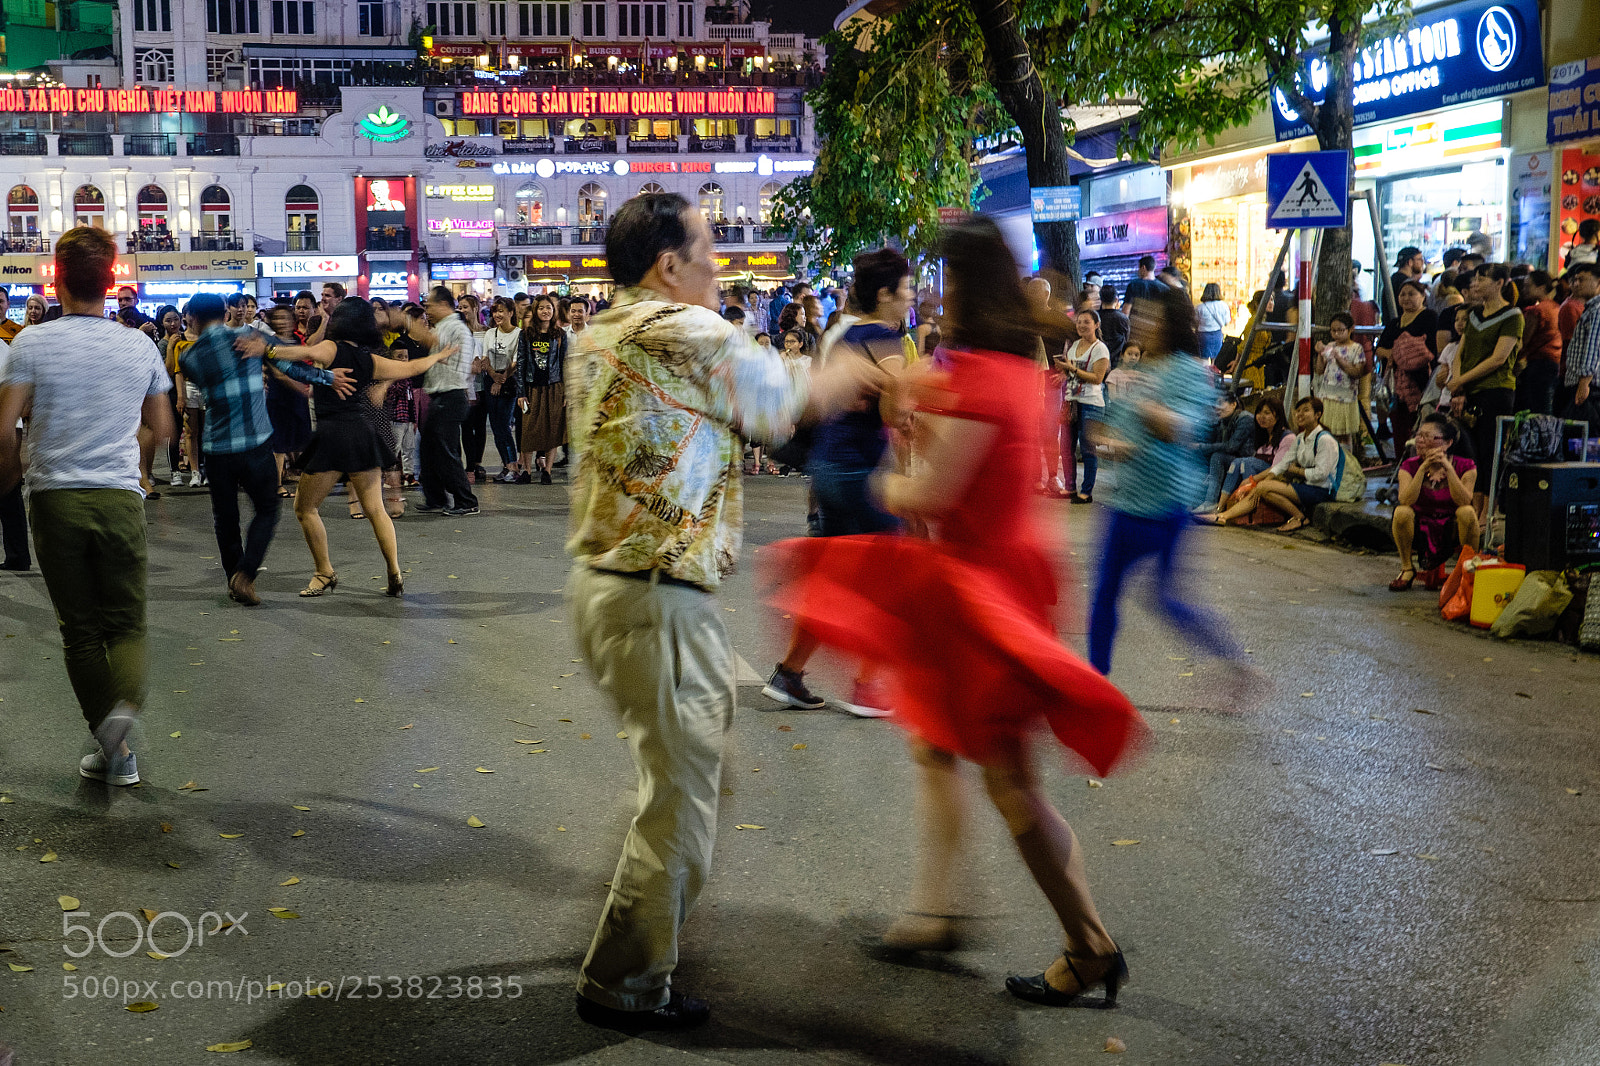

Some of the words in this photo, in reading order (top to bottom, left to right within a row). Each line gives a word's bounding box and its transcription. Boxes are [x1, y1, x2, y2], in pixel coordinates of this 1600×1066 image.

[1408, 18, 1461, 66] TOUR
[440, 46, 473, 54] COFFEE
[589, 47, 622, 55] BURGER
[691, 47, 745, 55] SANDWCH
[1391, 65, 1440, 96] OFFICE
[29, 83, 48, 112] XÃ
[50, 84, 74, 117] HỘI
[77, 82, 105, 112] CHỦ
[107, 85, 150, 112] NGHĨA
[153, 85, 183, 117] VIỆT
[185, 91, 216, 112] NAM
[222, 86, 263, 113] MUÔN
[266, 86, 297, 113] NĂM
[462, 86, 499, 114] ĐẢNG
[502, 87, 538, 118] CỘNG
[541, 85, 568, 113] SẢN
[570, 87, 597, 117] VIỆT
[600, 91, 629, 113] NAM
[630, 91, 673, 115] QUANG
[676, 91, 706, 113] VINH
[707, 86, 744, 113] MUÔN
[746, 87, 775, 113] NĂM
[425, 144, 445, 156] the
[444, 140, 492, 157] Kitchen
[630, 162, 678, 173] BURGER
[681, 162, 711, 173] KING
[1112, 224, 1129, 239] WAY
[2, 265, 32, 275] Nikon
[274, 261, 313, 273] HSBC
[582, 258, 607, 267] Coffee
[371, 271, 408, 286] KFC
